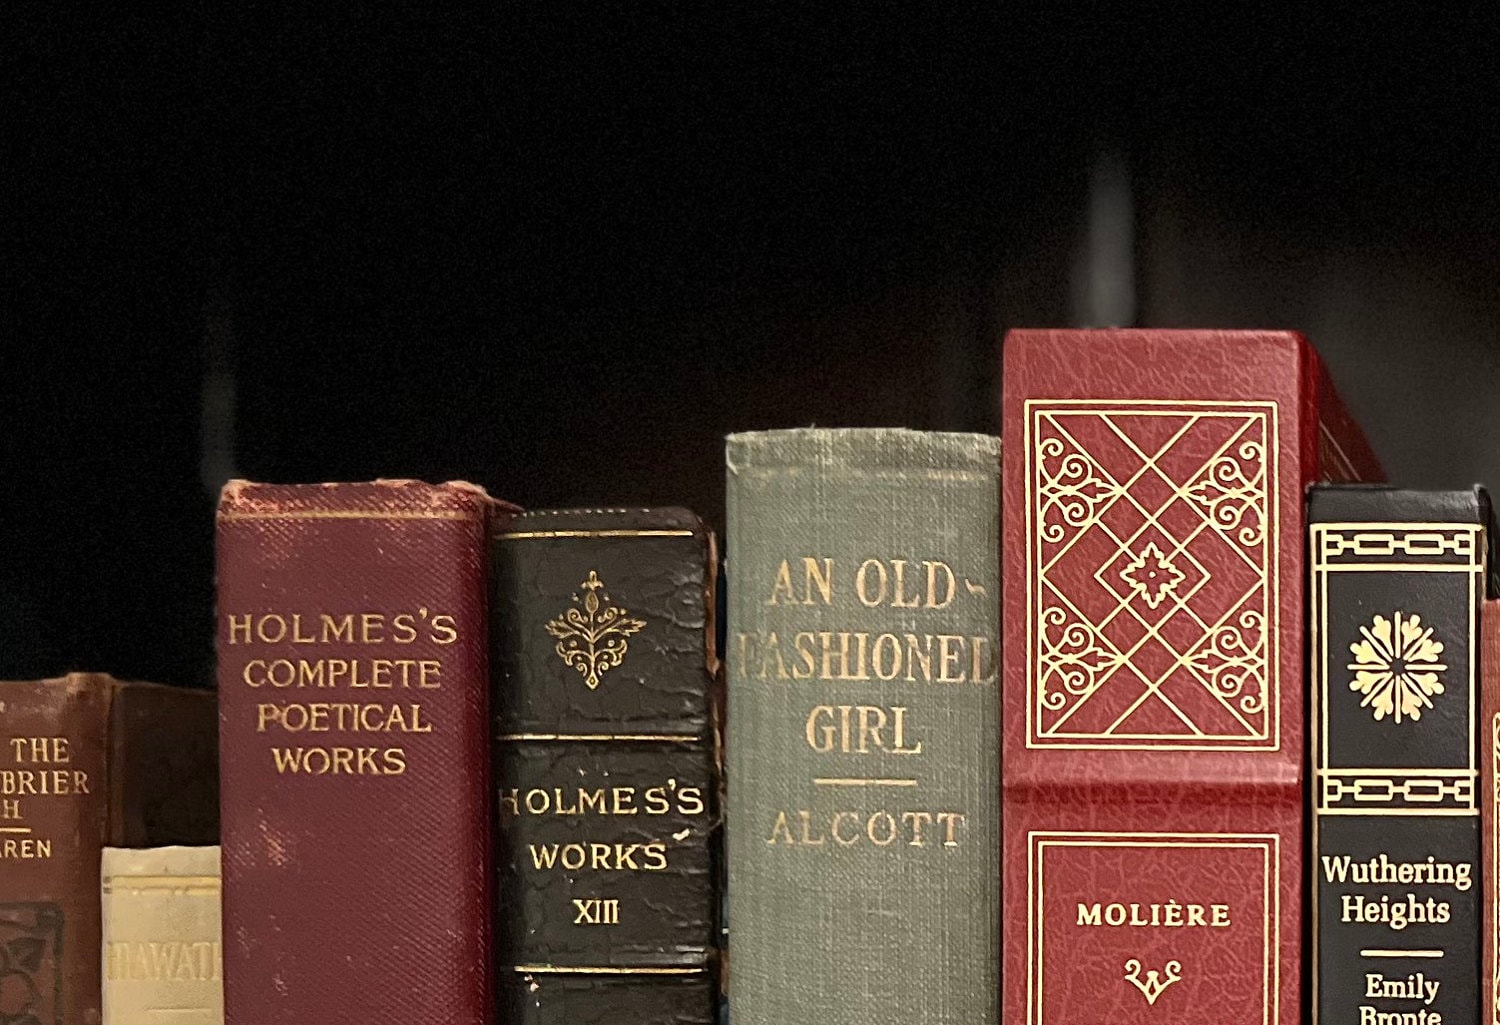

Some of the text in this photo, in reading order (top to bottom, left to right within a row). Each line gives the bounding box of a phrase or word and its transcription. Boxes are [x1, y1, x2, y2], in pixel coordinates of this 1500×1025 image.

[769, 557, 835, 605] AN
[228, 607, 457, 645] HOLMES'S
[243, 660, 442, 689] COMPLETE
[257, 703, 432, 733] POETICAL
[806, 705, 922, 754] GIRL
[10, 737, 70, 763] THE
[271, 748, 406, 775] WORKS
[767, 810, 966, 847] ALCOTT
[0, 839, 52, 859] REN
[529, 841, 668, 870] WORKS
[1322, 855, 1473, 891] Wuthering
[1076, 899, 1232, 927] MOLIÈRE
[1341, 894, 1451, 930] Heights
[1365, 972, 1440, 1003] Emily
